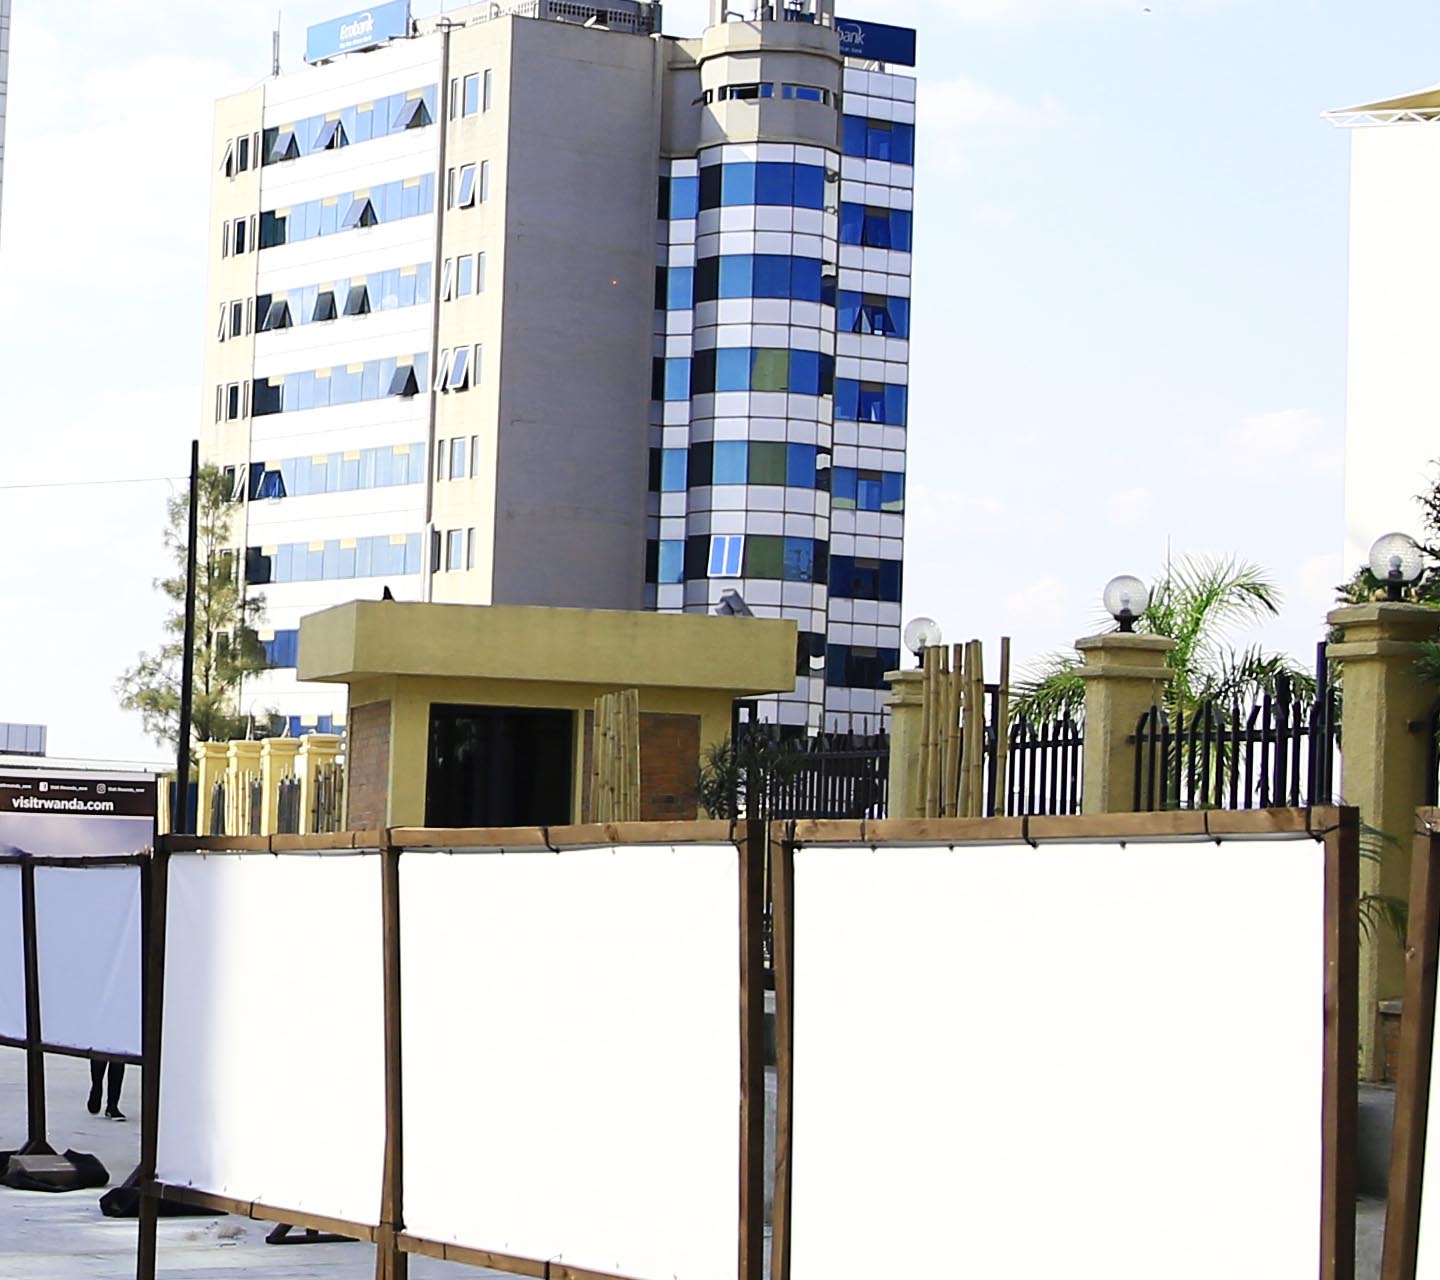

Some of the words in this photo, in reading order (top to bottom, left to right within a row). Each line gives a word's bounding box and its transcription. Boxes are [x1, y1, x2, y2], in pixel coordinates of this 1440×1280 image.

[339, 12, 374, 40] Ecobank
[837, 24, 865, 45] bank
[12, 794, 115, 811] visitrwanda.com
